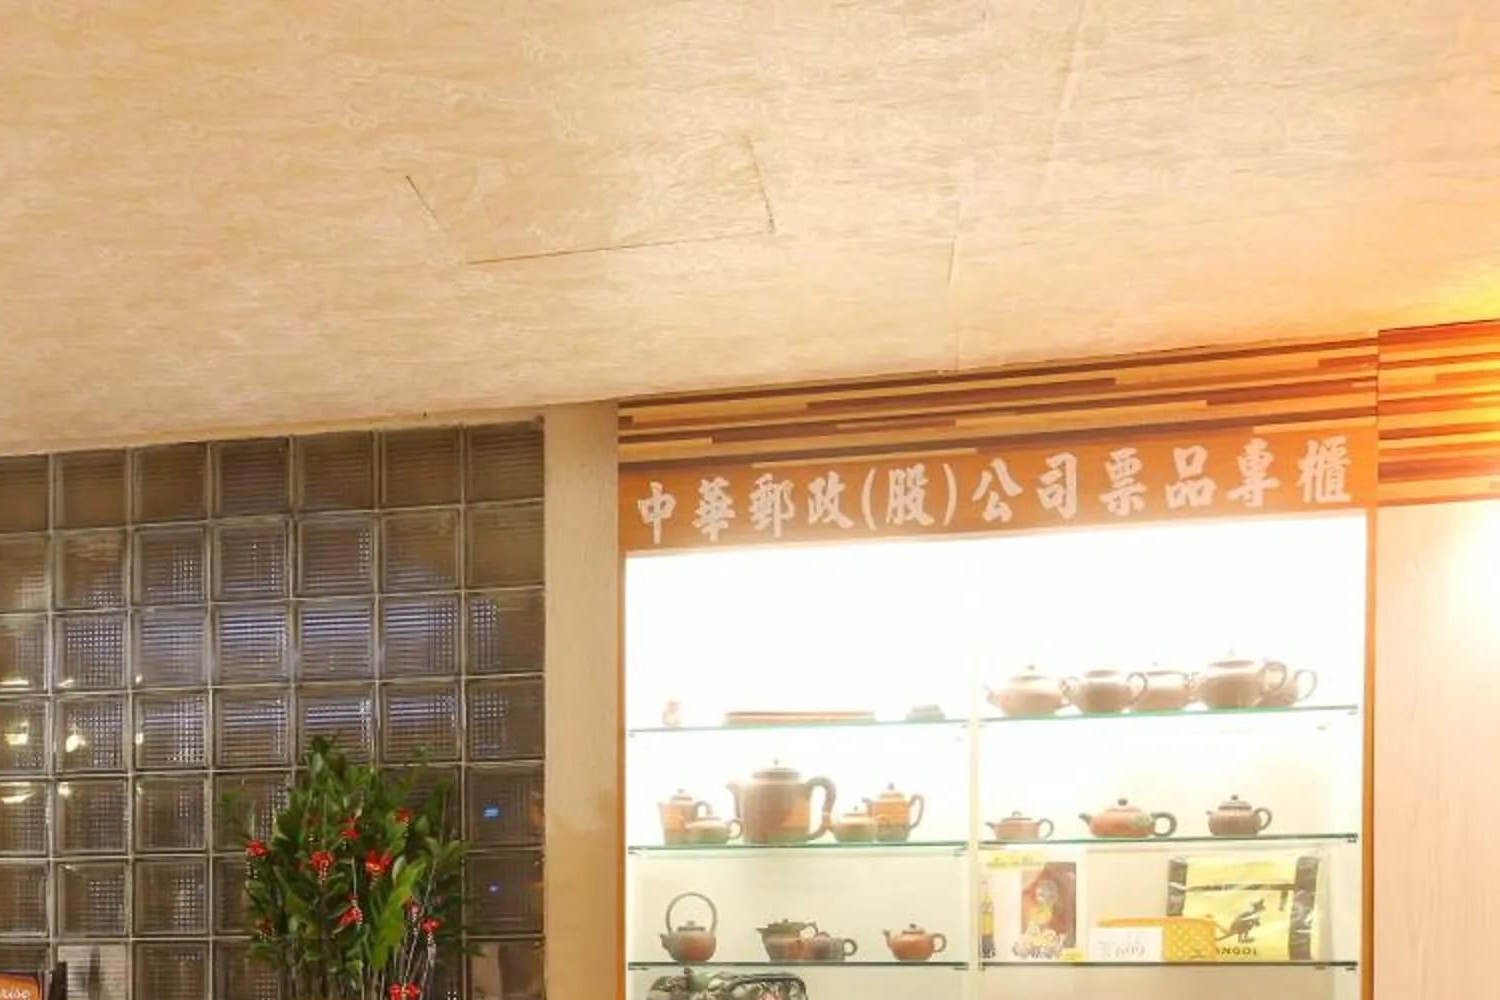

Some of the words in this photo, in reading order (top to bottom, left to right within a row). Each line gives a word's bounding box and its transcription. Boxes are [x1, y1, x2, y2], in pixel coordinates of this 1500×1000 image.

[637, 435, 1352, 544] 中華郵政(股)公司票品專櫃
